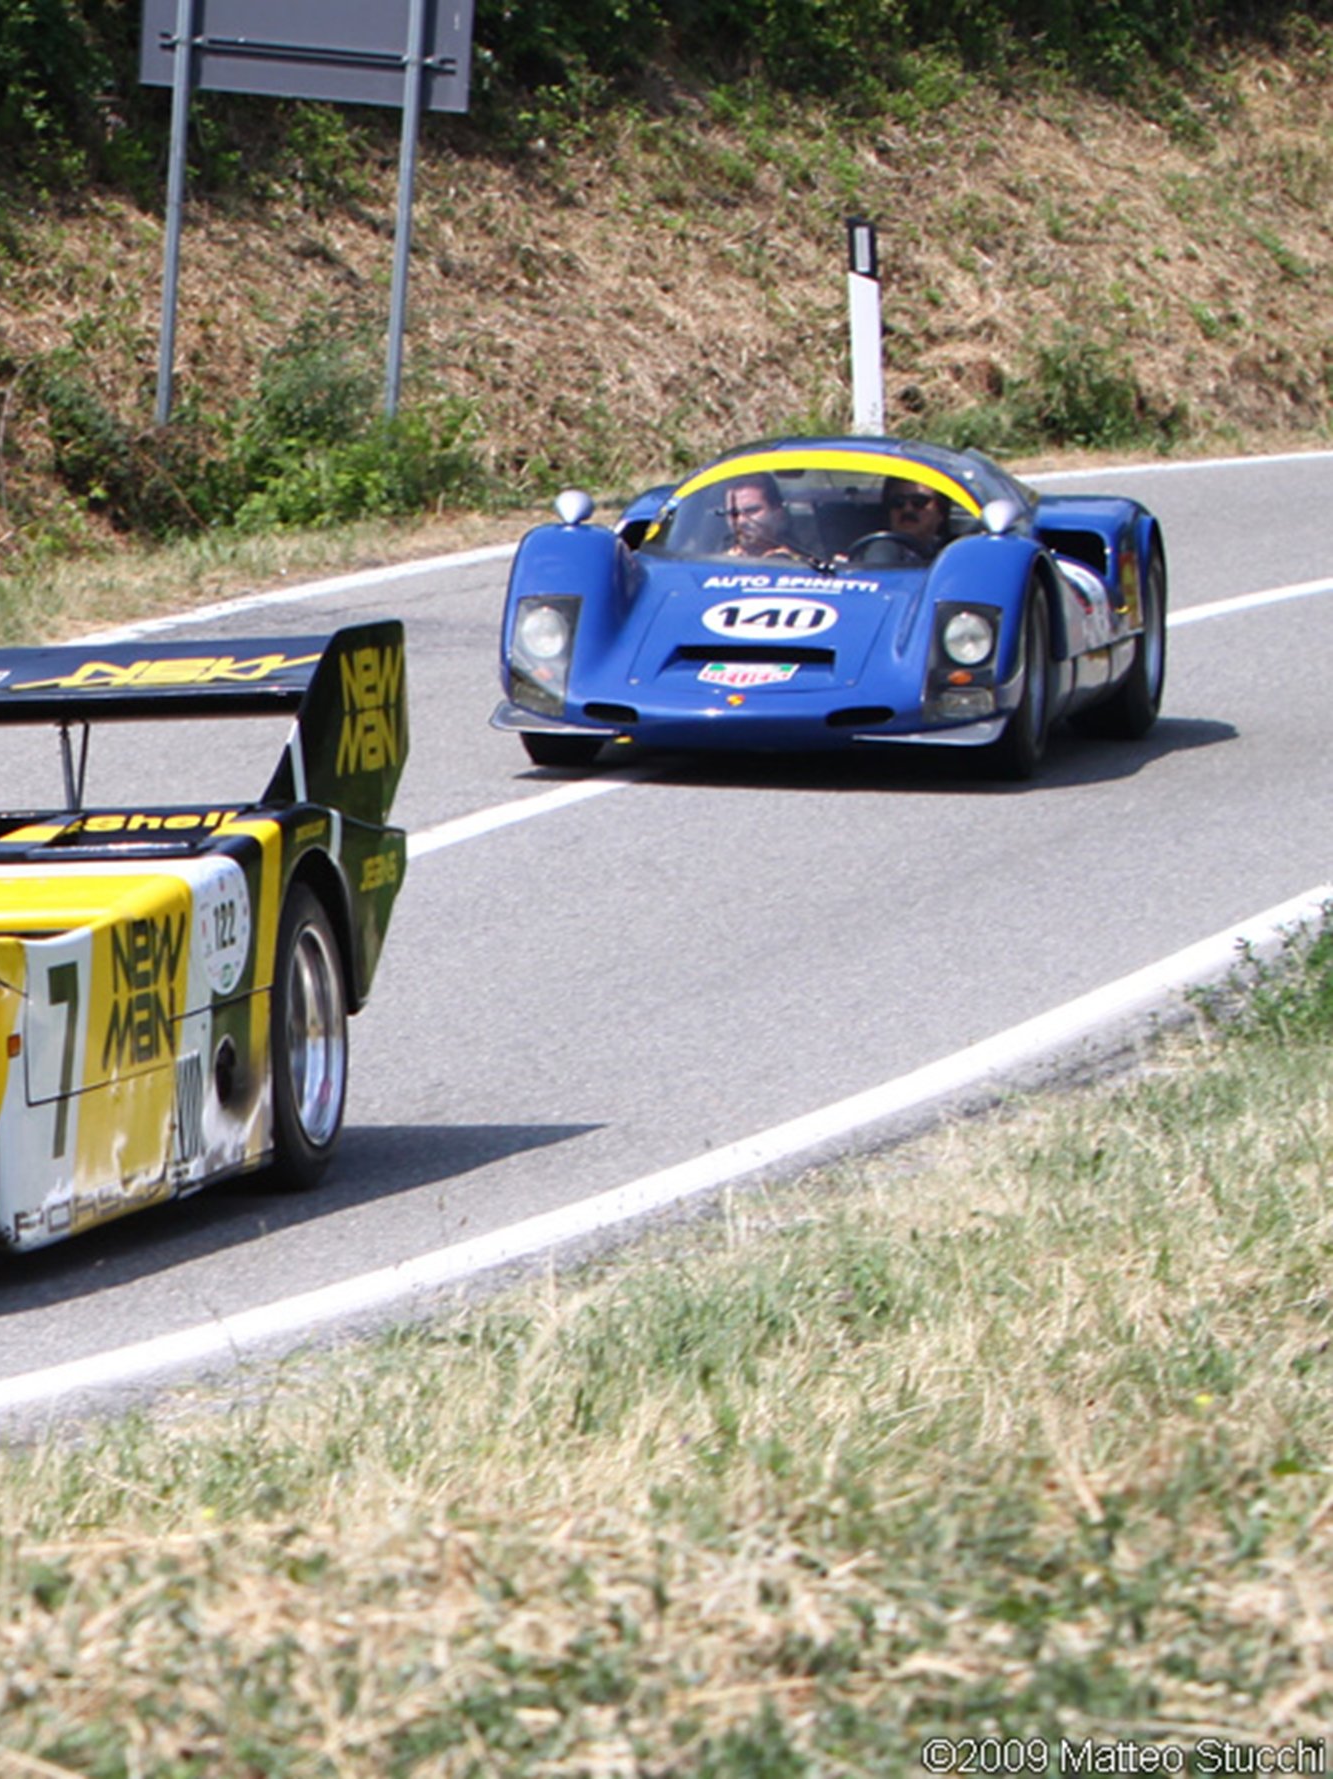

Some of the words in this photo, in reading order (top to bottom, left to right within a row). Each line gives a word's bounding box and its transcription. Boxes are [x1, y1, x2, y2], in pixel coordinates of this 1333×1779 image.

[703, 576, 771, 588] AUTO
[776, 577, 879, 592] SPINETTI
[719, 607, 826, 628] 140
[83, 811, 238, 832] Shell
[213, 900, 236, 949] 122
[48, 961, 79, 1160] 7
